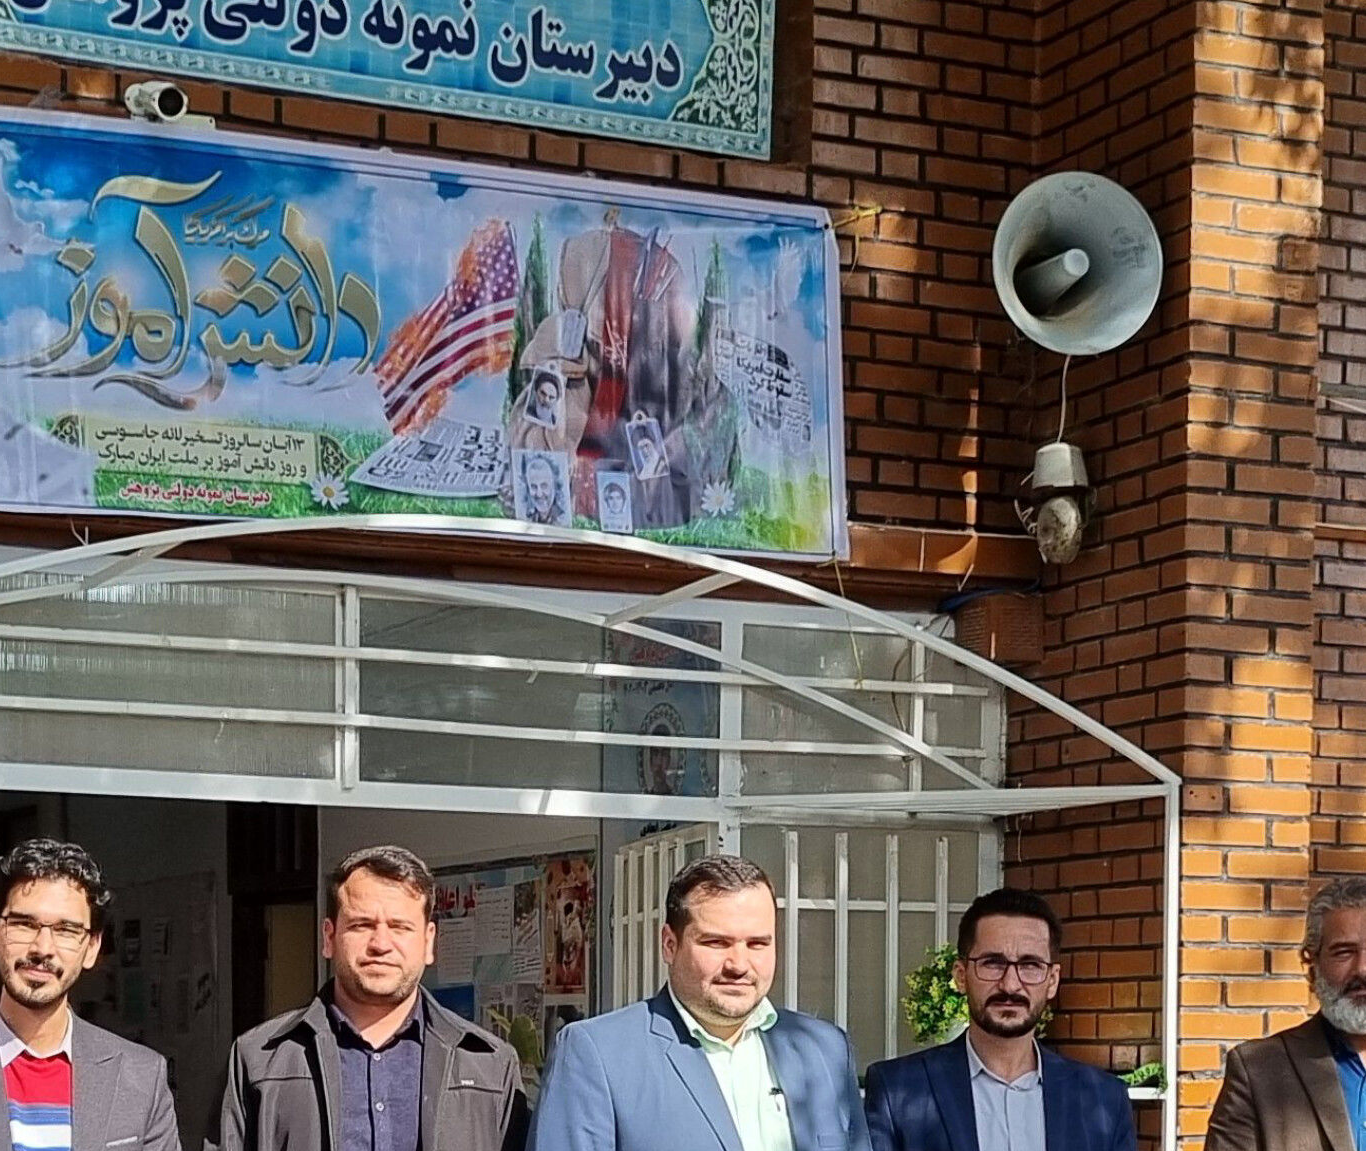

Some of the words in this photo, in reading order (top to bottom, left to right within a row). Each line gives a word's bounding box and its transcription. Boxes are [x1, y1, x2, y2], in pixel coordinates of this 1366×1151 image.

[491, 7, 682, 102] دبیرستان
[95, 423, 159, 444] جاسوسی
[161, 425, 183, 441] لانه
[182, 430, 223, 447] تسخیر
[222, 433, 263, 452] سالروز
[98, 442, 136, 465] مبارک
[262, 434, 292, 455] آبان
[138, 446, 167, 468] ایران
[168, 449, 199, 465] ملت
[202, 457, 214, 471] بر
[216, 452, 242, 473] آموز
[243, 456, 276, 475] دانش
[278, 460, 298, 477] روز
[300, 464, 308, 479] و
